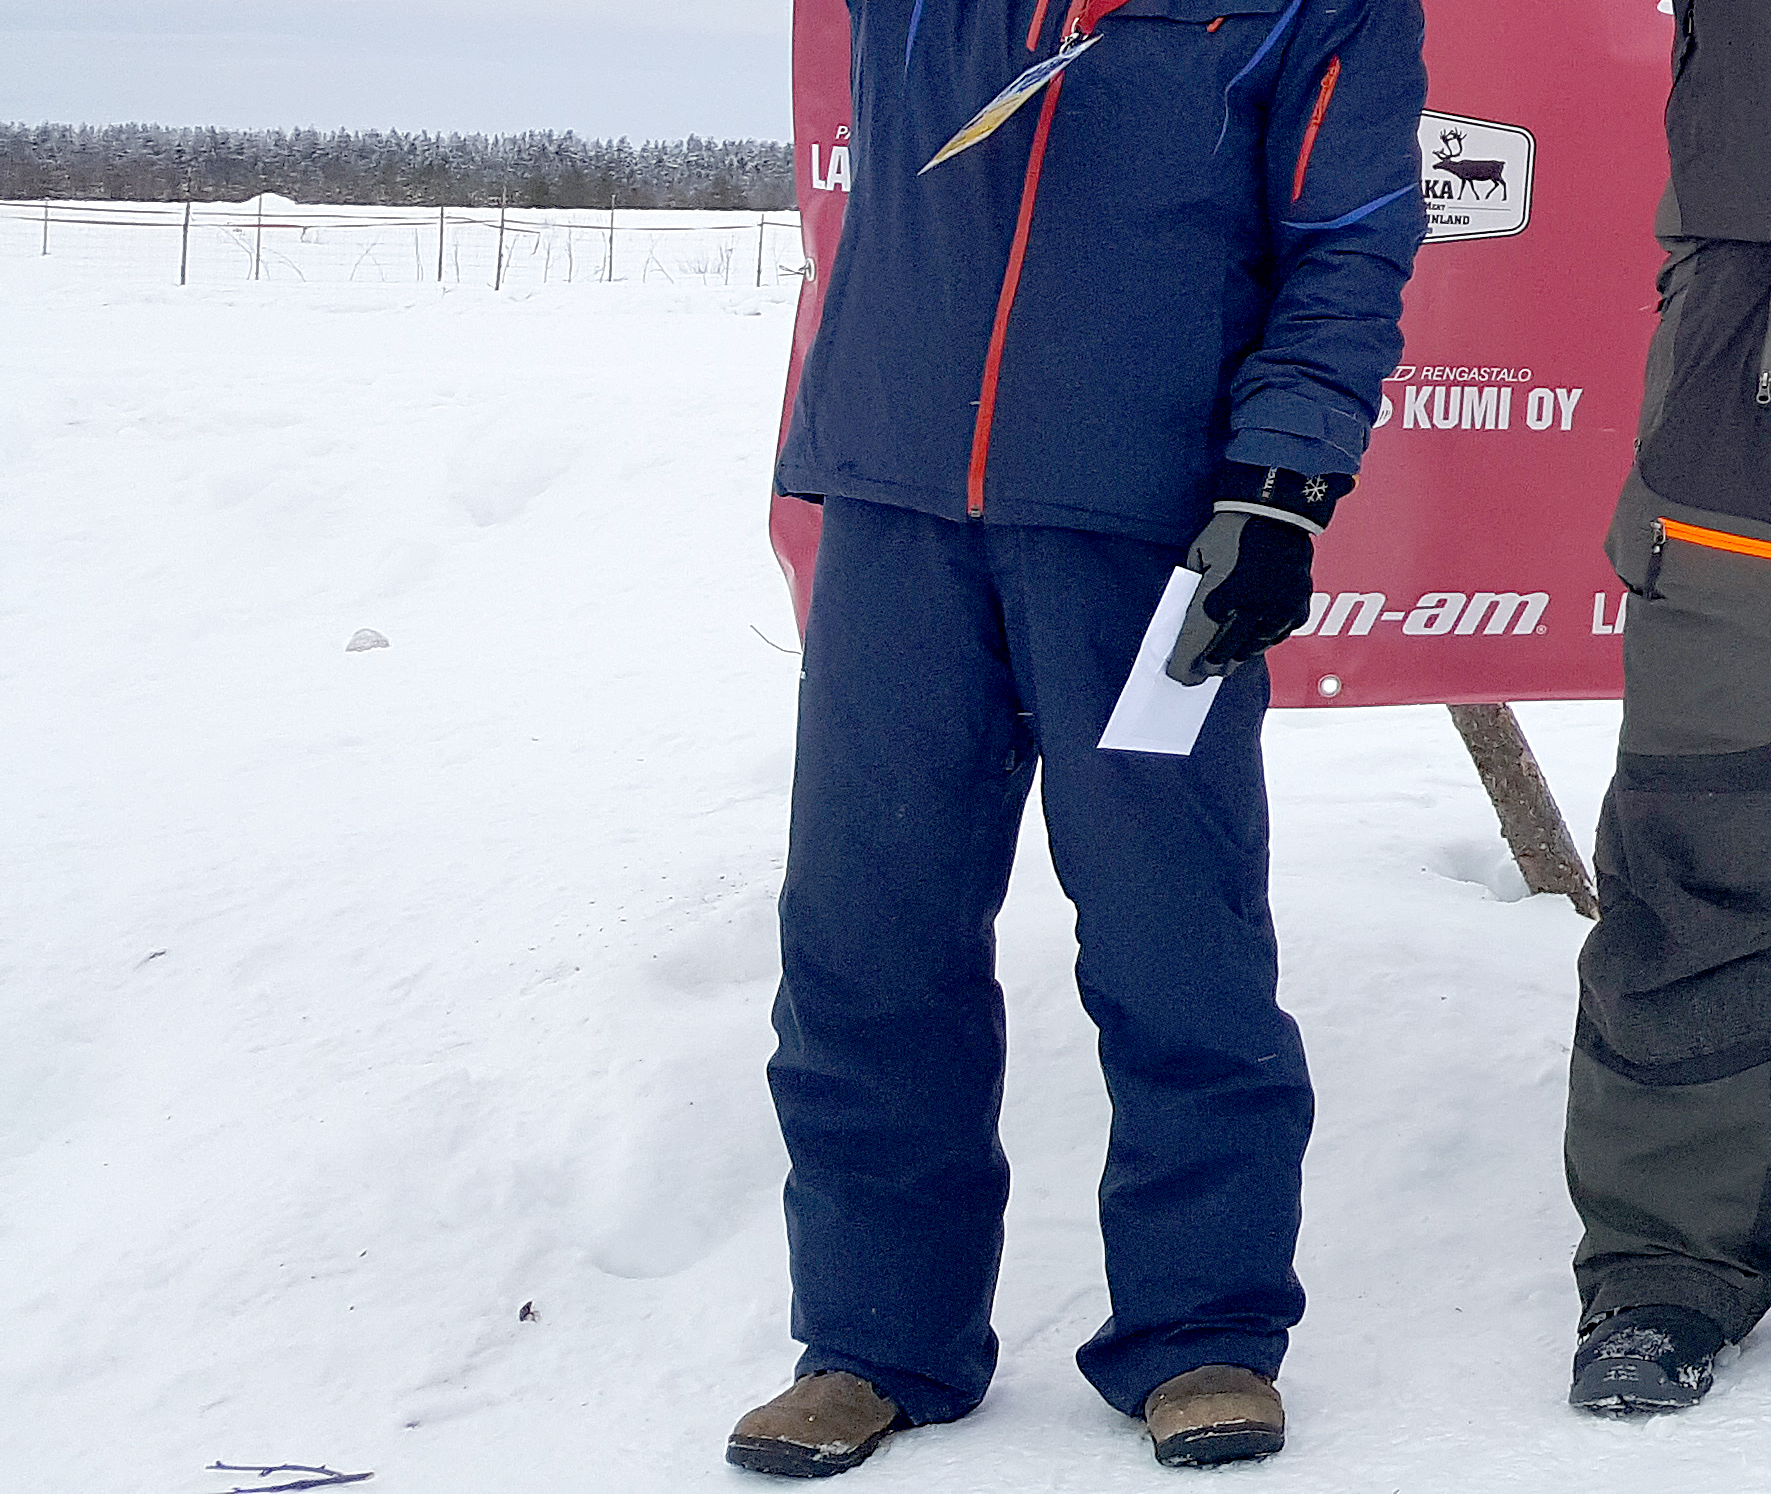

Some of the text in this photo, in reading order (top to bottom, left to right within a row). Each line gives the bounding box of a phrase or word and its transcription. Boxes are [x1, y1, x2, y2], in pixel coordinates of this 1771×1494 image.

[1421, 366, 1532, 382] RENGASTALO
[1403, 385, 1583, 431] KUMI OY
